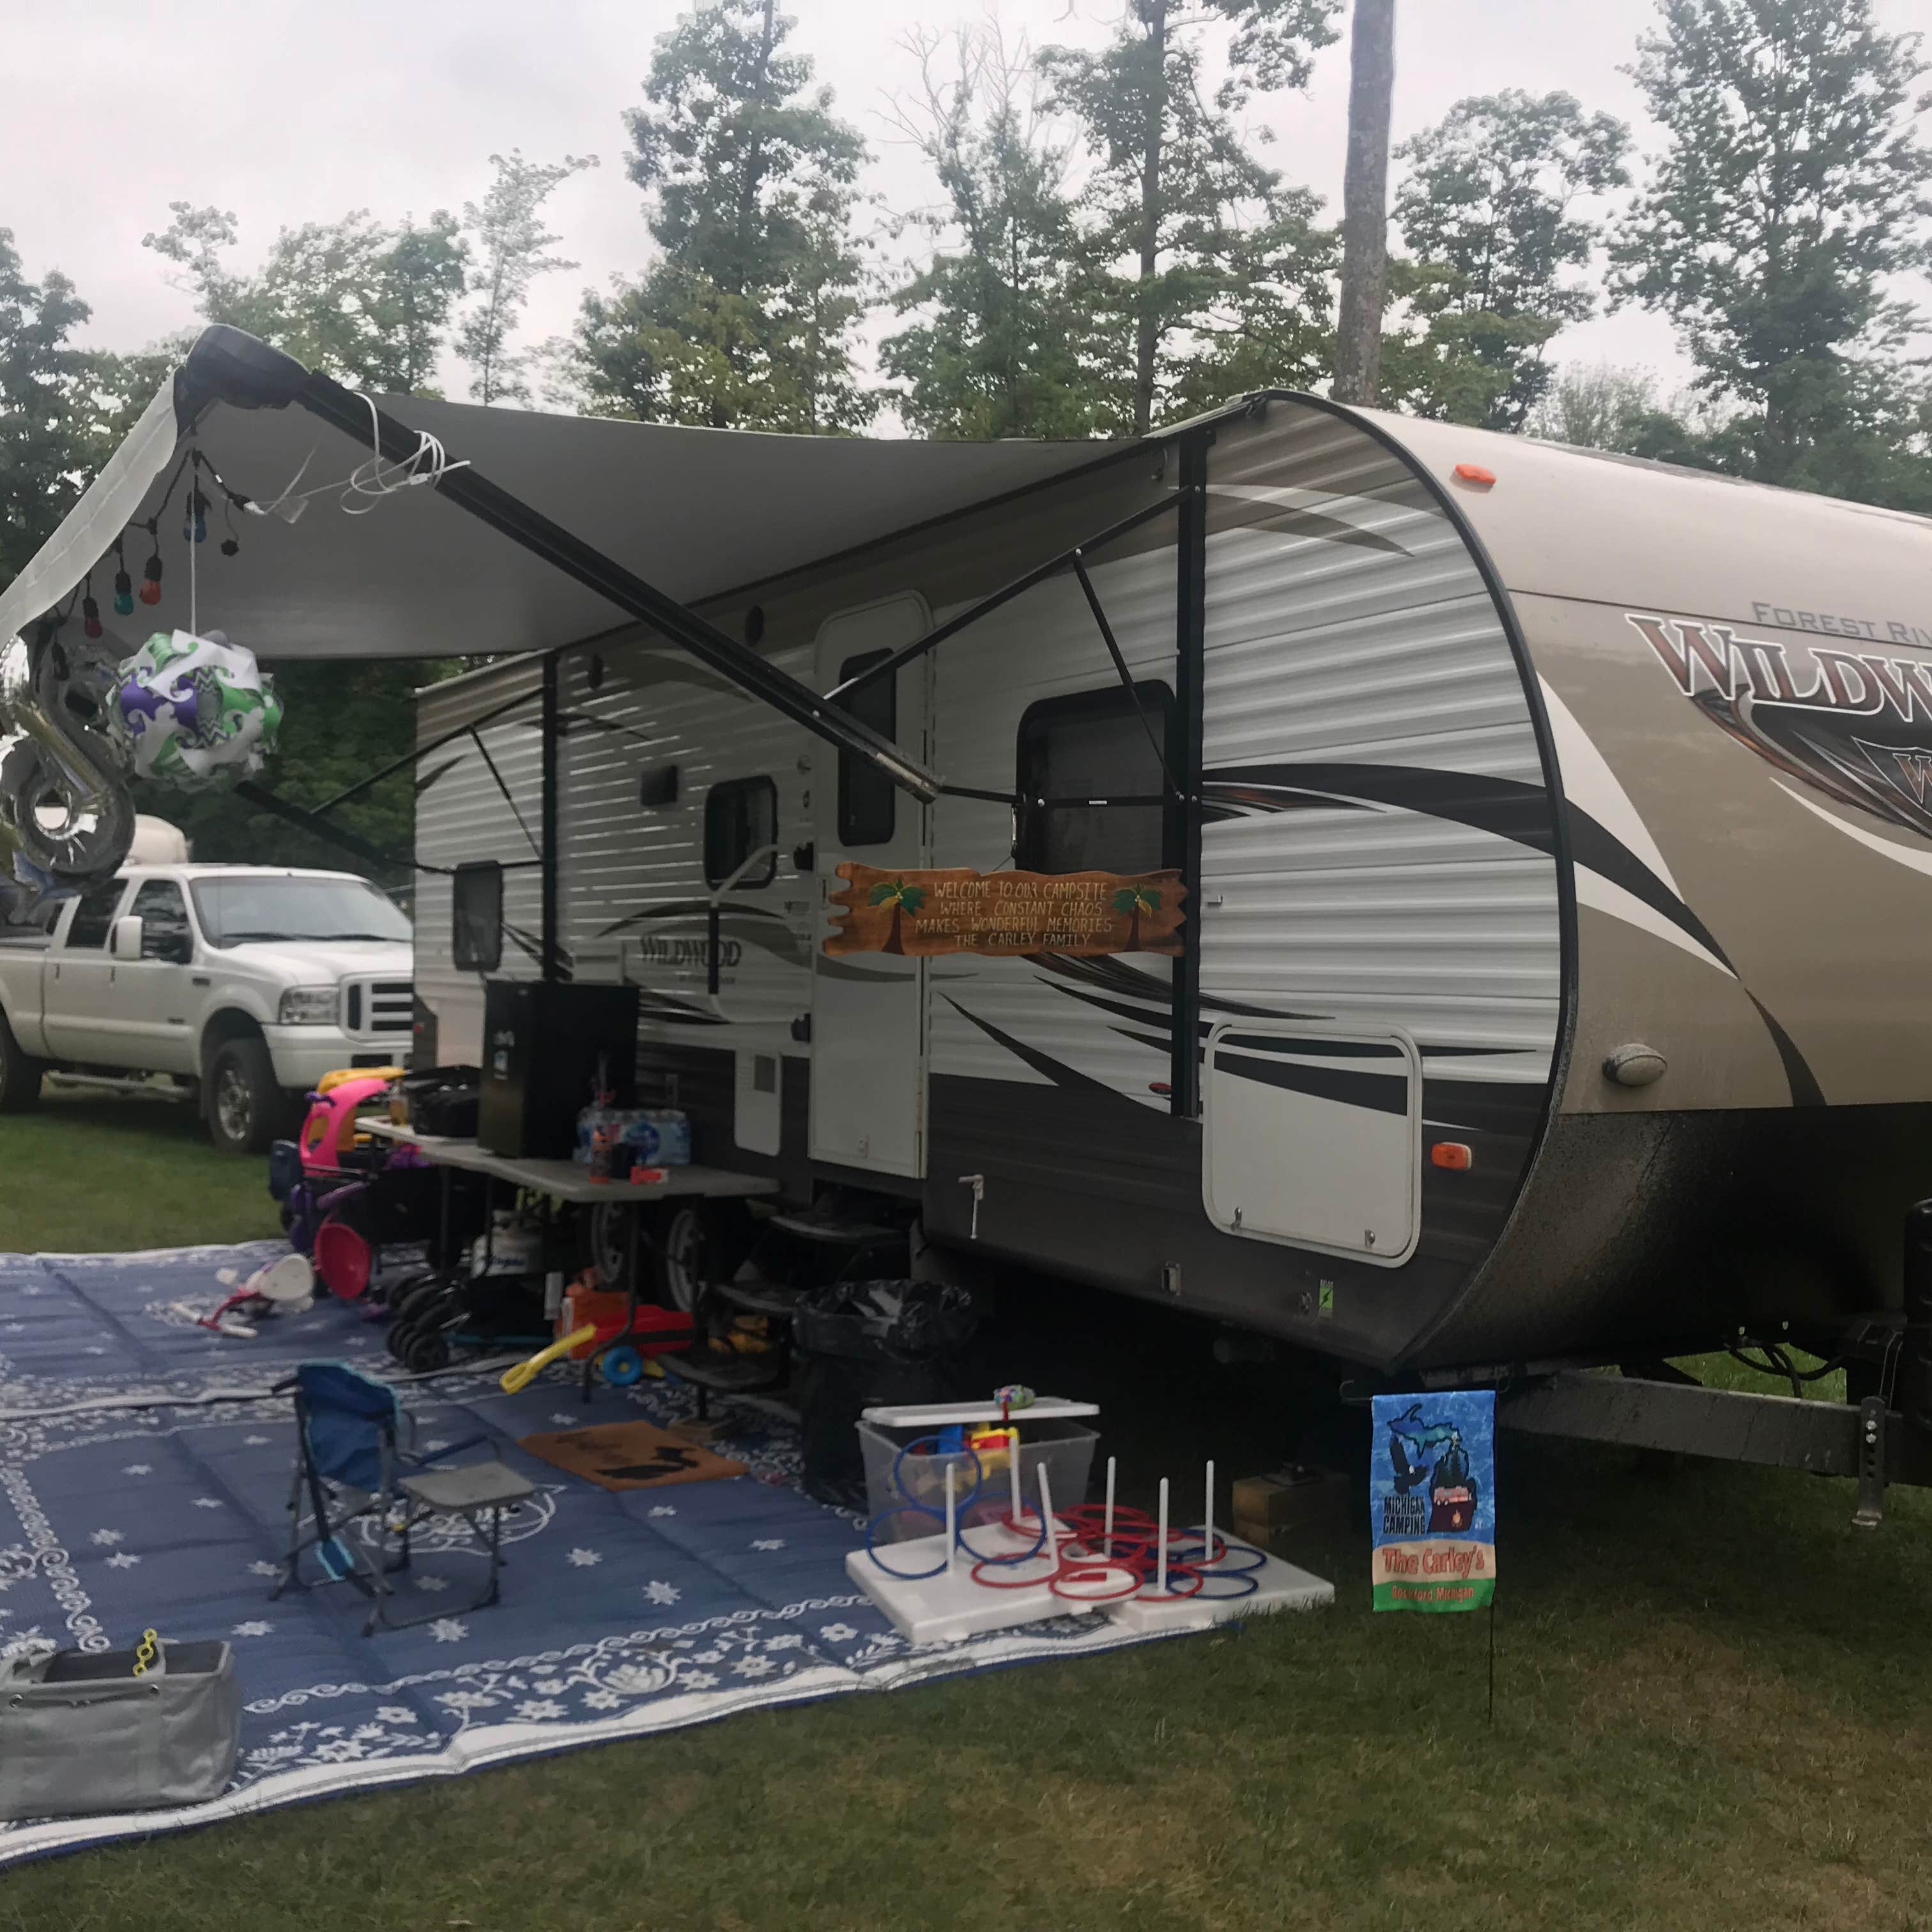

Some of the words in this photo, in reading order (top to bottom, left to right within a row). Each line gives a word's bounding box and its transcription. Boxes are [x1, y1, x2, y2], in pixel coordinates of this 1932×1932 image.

[1751, 601, 1876, 638] FOREST
[934, 881, 990, 898] WELCOME
[999, 881, 1013, 898] TO
[1015, 882, 1038, 898] OUR
[1043, 882, 1108, 901] CAMPSITE
[940, 901, 982, 916] WHERE
[994, 900, 1054, 916] CONSTANT
[1061, 901, 1102, 916] CHAOS
[915, 918, 960, 934] MAKES
[971, 916, 1039, 931] WONDERFUL
[1046, 917, 1112, 933] MEMORIES
[954, 934, 978, 946] THE
[988, 932, 1036, 946] CARLEY
[1043, 933, 1091, 947] FAMILY
[641, 936, 742, 967] WILDWOOD
[1384, 1496, 1425, 1515] MICHIGAN
[1383, 1514, 1425, 1535] CAMPING
[1382, 1547, 1419, 1575] The
[1423, 1545, 1485, 1579] Carley's
